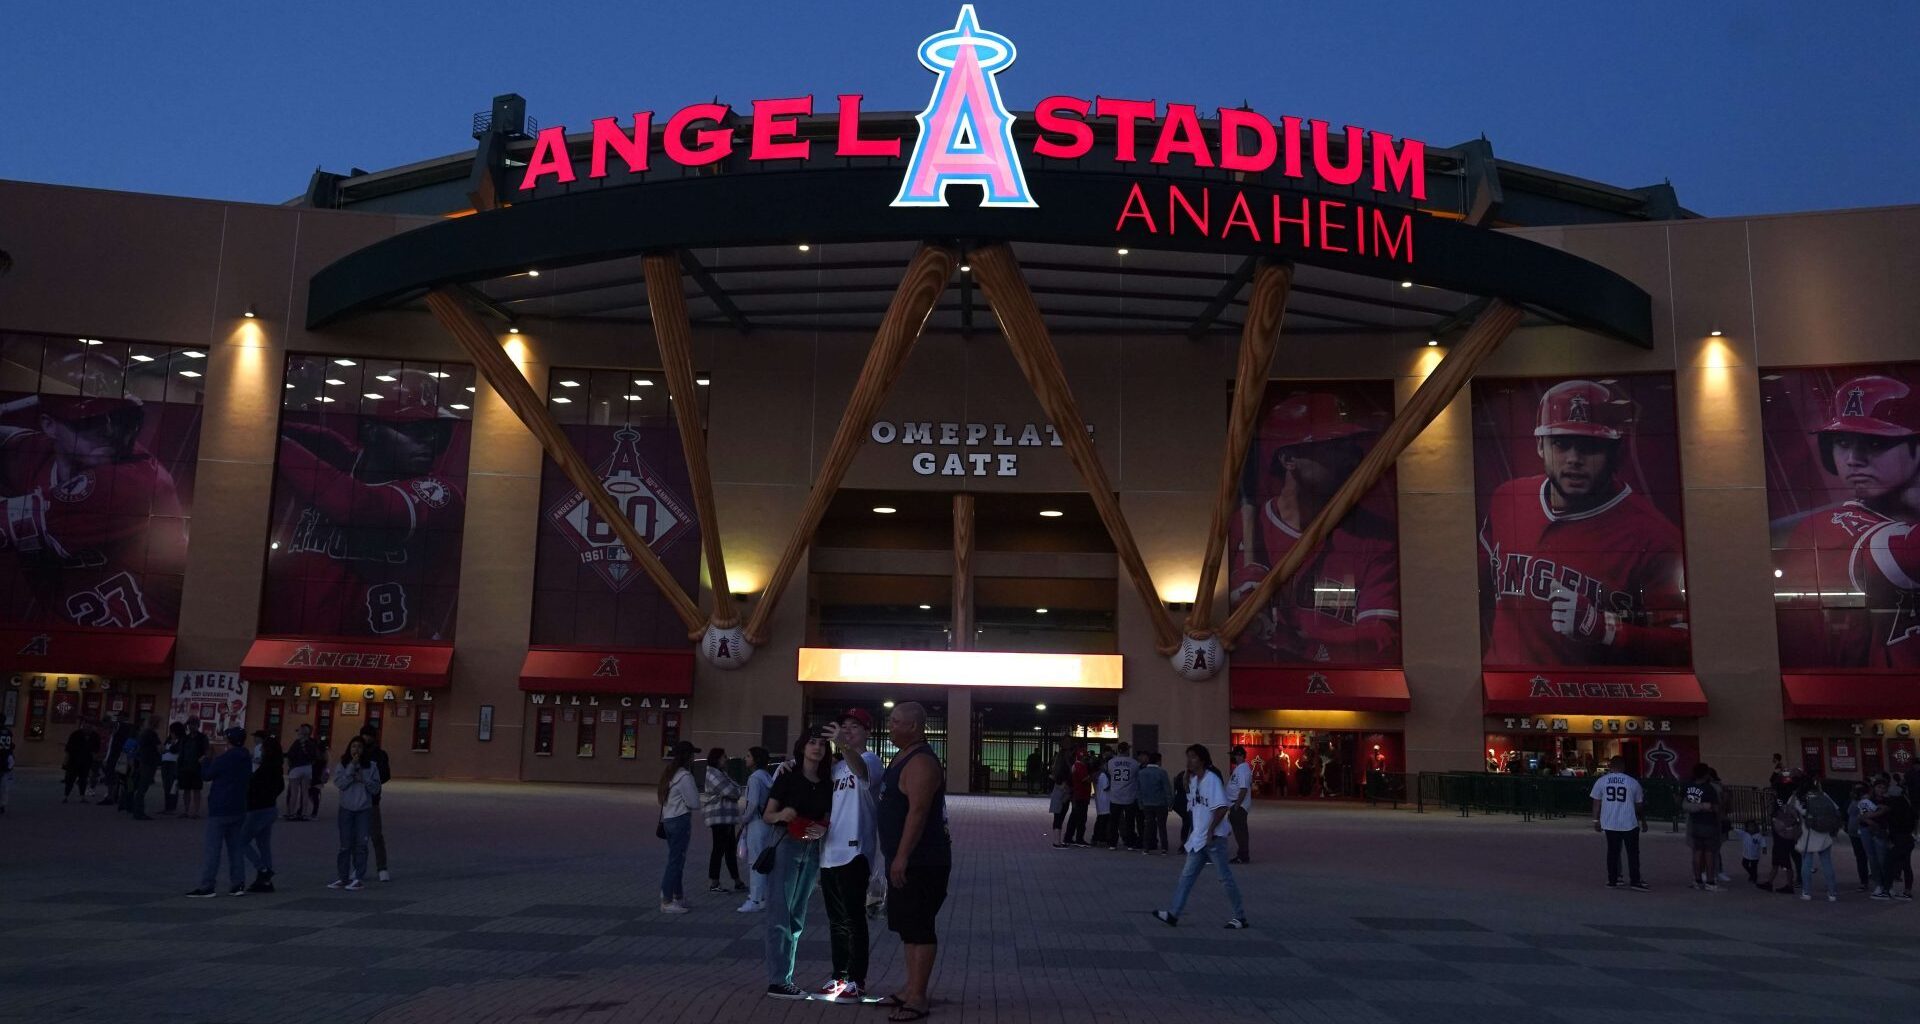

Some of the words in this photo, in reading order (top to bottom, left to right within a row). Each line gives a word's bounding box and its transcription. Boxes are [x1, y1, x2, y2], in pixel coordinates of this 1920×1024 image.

[519, 94, 902, 190] ANGEL
[1033, 96, 1427, 201] STADIUM
[1114, 182, 1415, 263] ANAHEIM
[865, 421, 1094, 446] OMEPLAT
[912, 452, 1017, 476] GATE
[553, 497, 577, 520] ANGELS
[656, 489, 693, 525] ANNIVERSARY
[580, 549, 604, 564] 1961
[66, 571, 149, 628] 27
[366, 582, 408, 634] 8
[284, 644, 412, 670] ANGELS
[179, 673, 244, 695] ANGELS
[270, 685, 340, 698] WILL
[363, 689, 433, 701] CALL
[1529, 675, 1662, 699] ANGELS
[532, 694, 599, 706] WILL
[621, 697, 689, 709] CALL
[1504, 717, 1568, 730] TEAM
[1593, 718, 1672, 731] STORE
[1114, 769, 1130, 782] 23
[1606, 786, 1627, 802] 99
